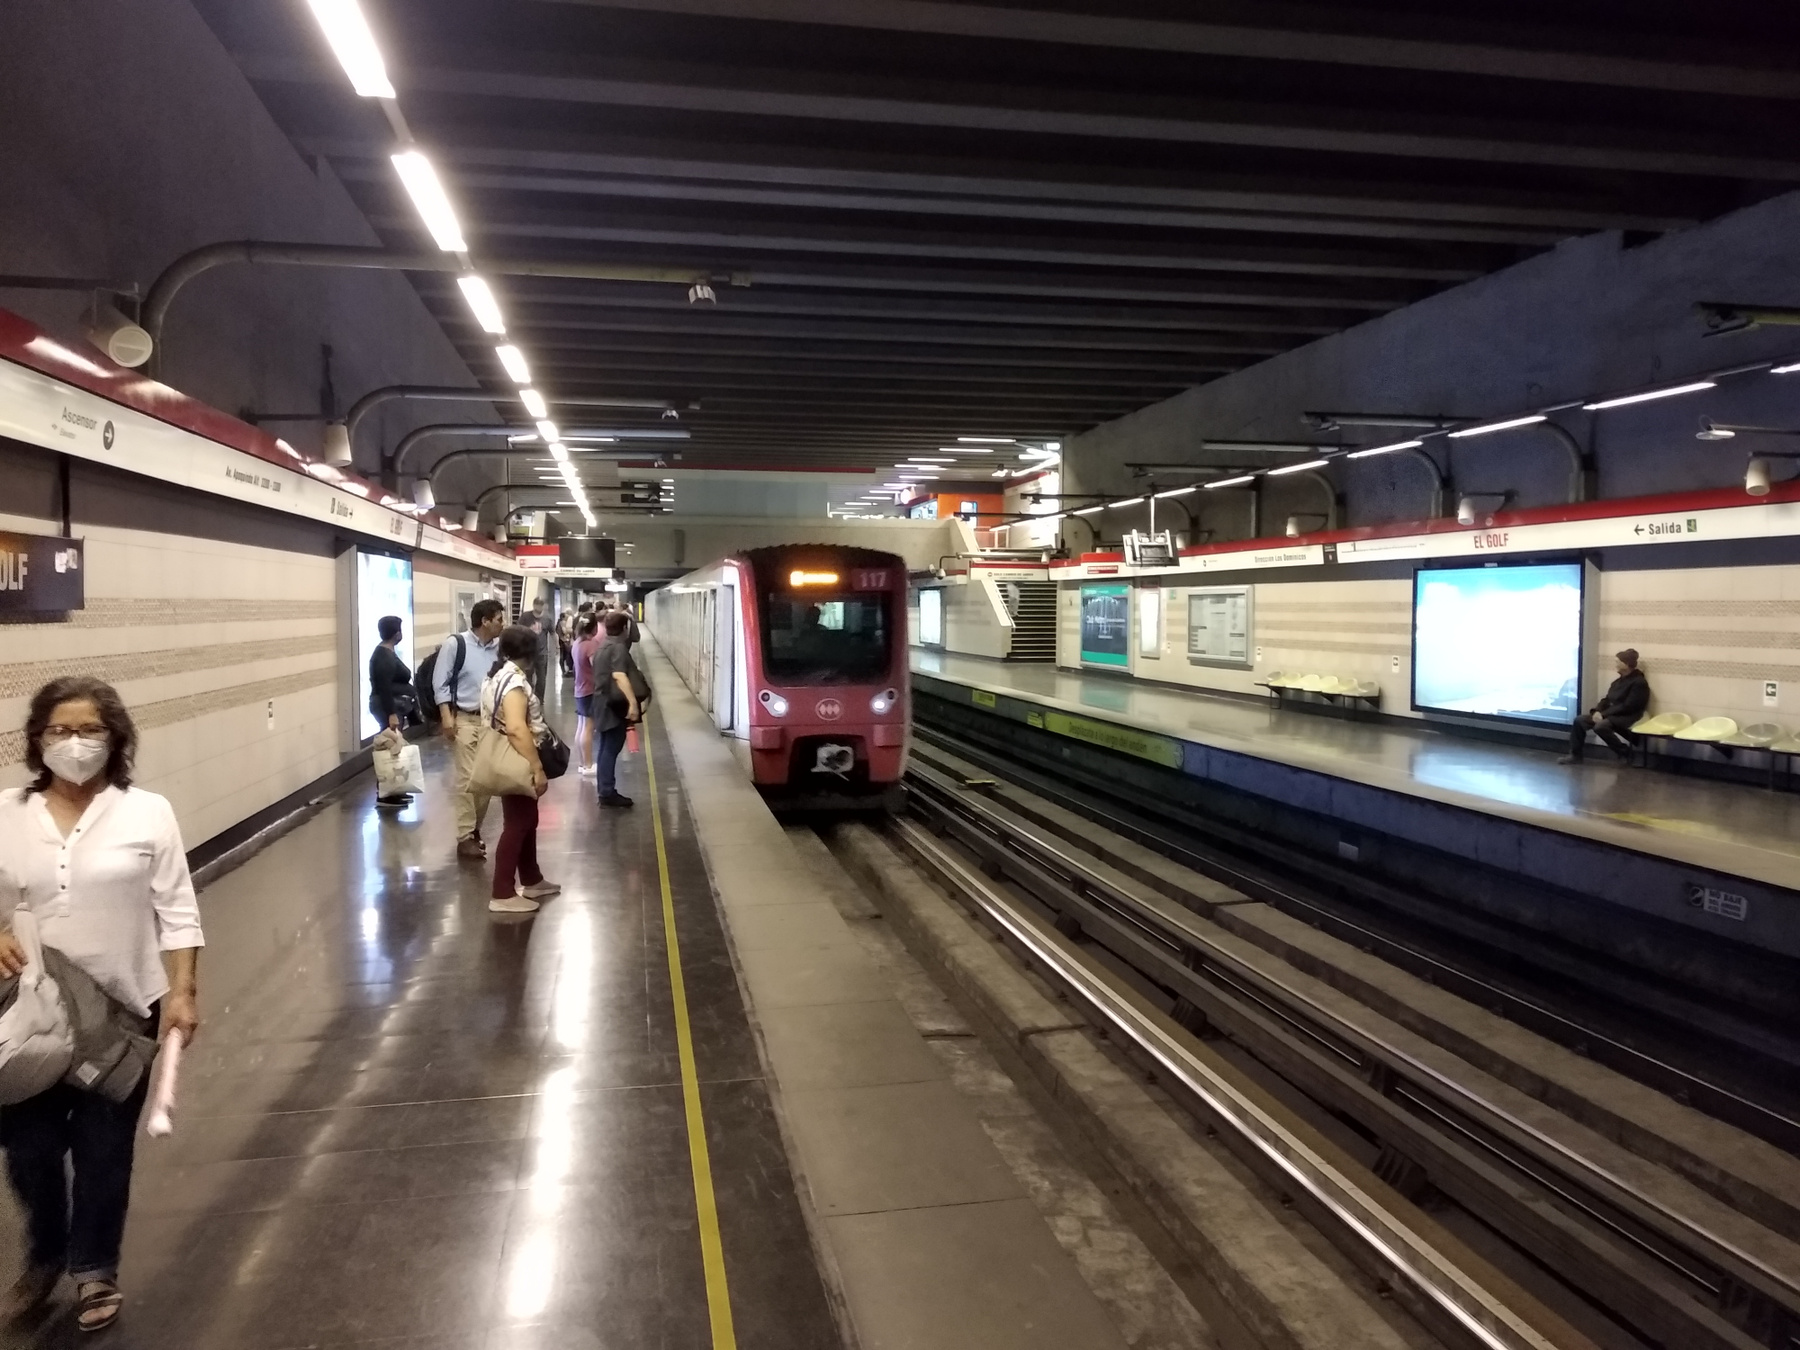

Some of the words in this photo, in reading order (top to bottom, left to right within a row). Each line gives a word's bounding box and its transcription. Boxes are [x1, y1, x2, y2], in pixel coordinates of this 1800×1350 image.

[62, 406, 97, 430] Ascensor
[1648, 522, 1682, 535] Salida
[1474, 535, 1484, 549] EL
[1486, 533, 1509, 548] GOLF
[861, 571, 886, 588] 117
